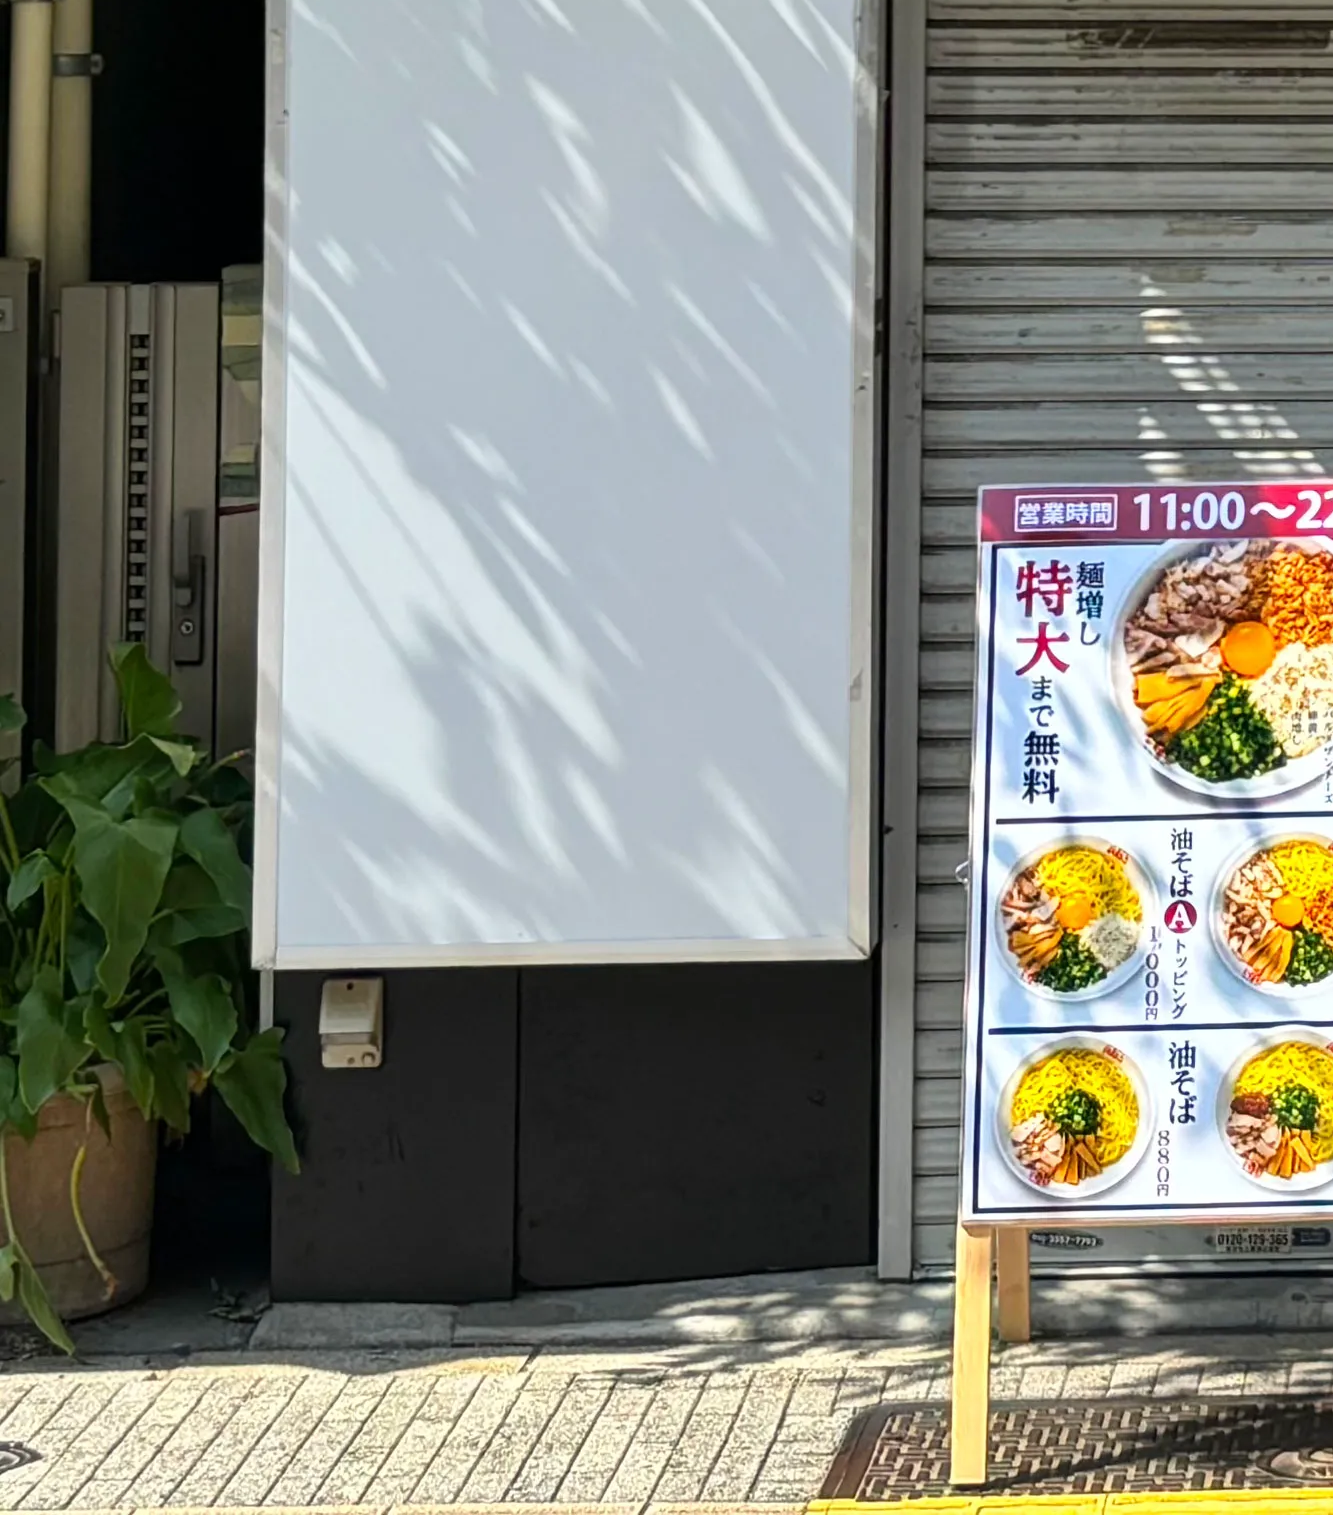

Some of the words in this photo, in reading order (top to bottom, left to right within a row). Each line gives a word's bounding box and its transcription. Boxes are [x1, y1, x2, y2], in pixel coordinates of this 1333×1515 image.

[1018, 501, 1114, 526] 営業時間
[1076, 560, 1105, 646] 麺増し
[1168, 1040, 1197, 1125] 油そば
[1156, 1130, 1170, 1197] 880円
